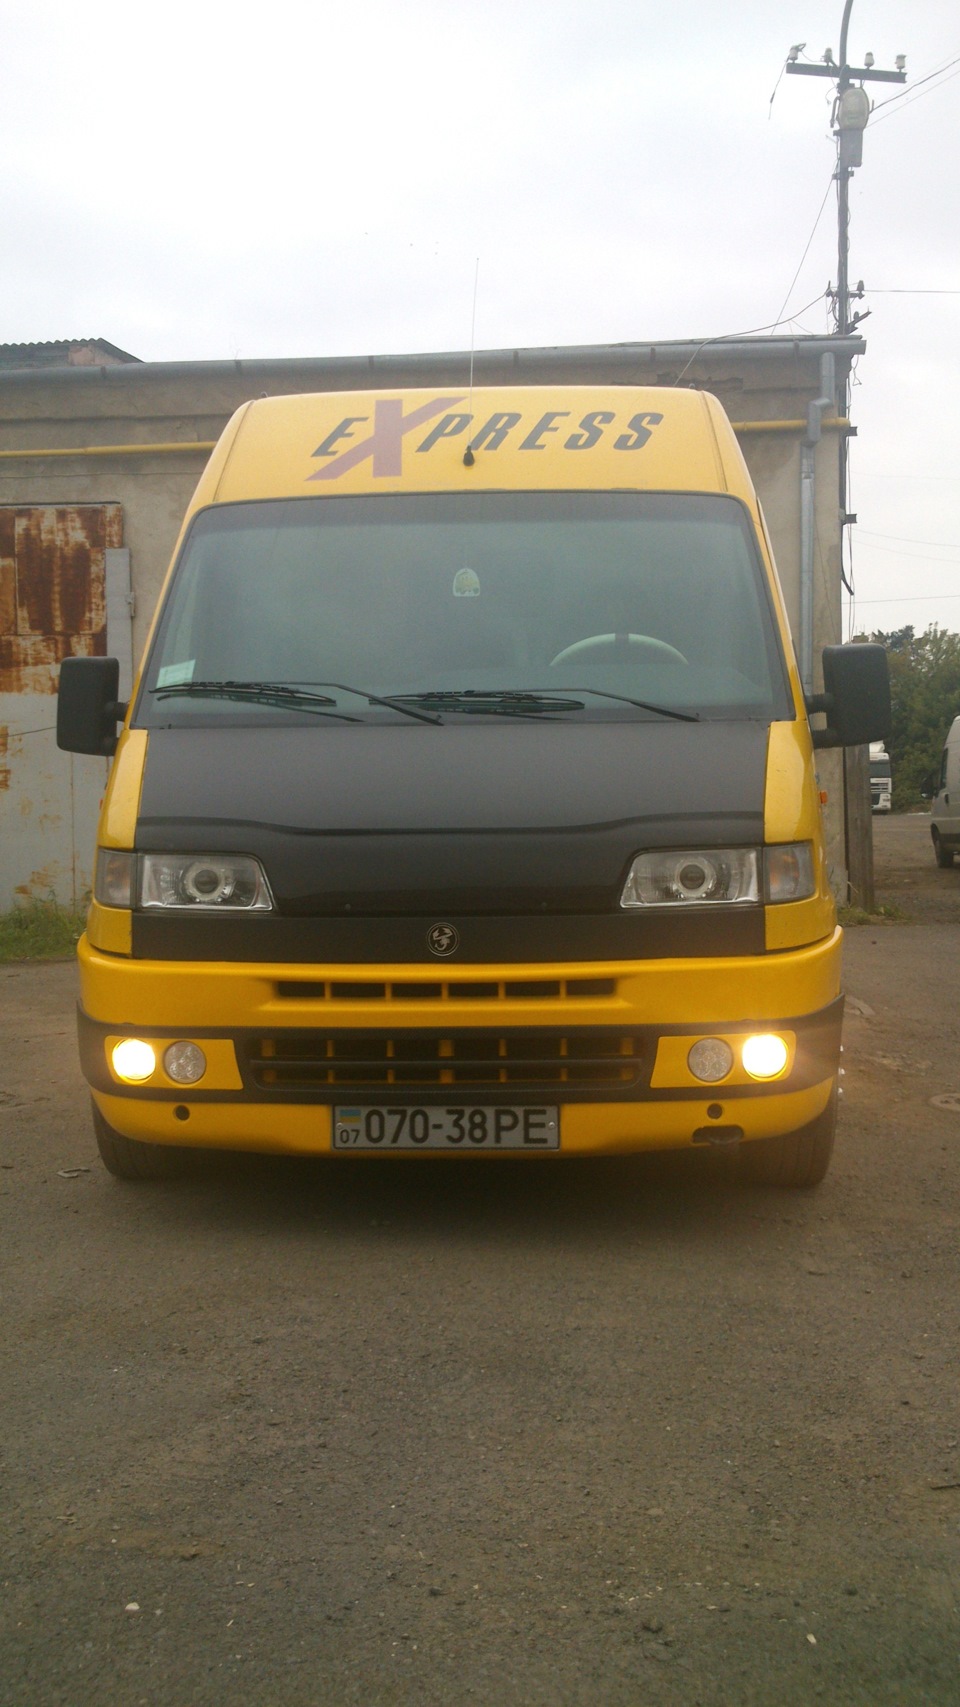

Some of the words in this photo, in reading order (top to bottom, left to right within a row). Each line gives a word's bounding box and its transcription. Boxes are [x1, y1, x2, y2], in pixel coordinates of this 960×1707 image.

[304, 397, 664, 481] EXPRESS
[340, 1129, 360, 1144] 07
[365, 1109, 547, 1144] 070-38PE
